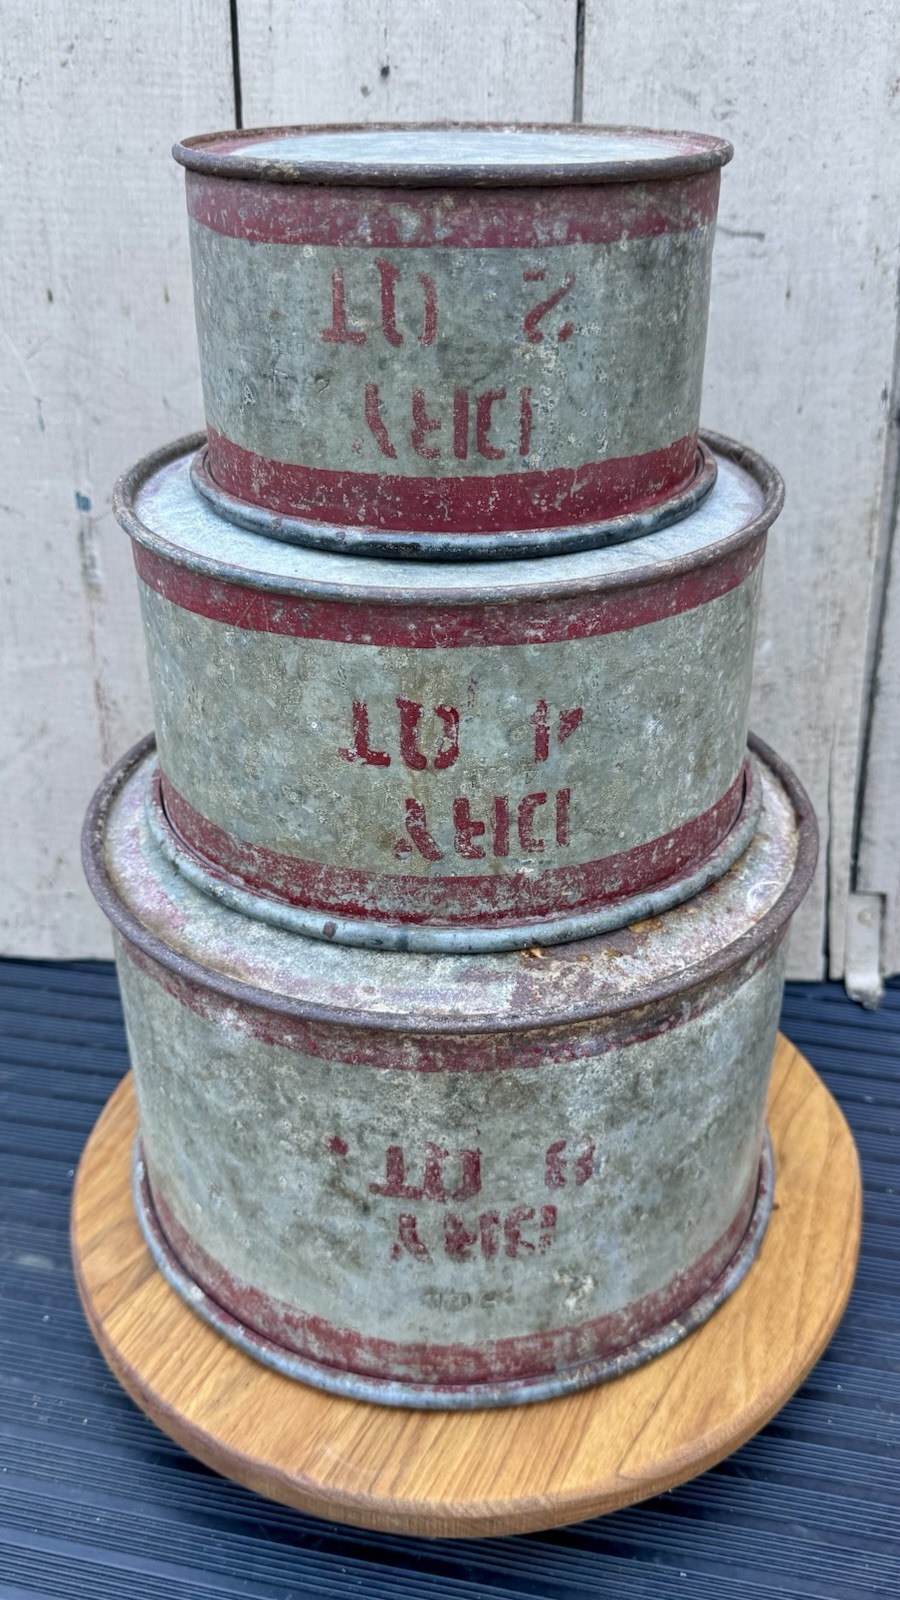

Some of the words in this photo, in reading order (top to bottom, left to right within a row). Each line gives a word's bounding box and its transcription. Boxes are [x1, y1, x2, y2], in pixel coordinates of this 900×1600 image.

[319, 257, 438, 347] QT
[522, 269, 576, 344] 2
[352, 382, 532, 460] DRY
[338, 695, 459, 770] QT
[530, 699, 584, 763] 4
[393, 787, 571, 861] DRY
[544, 1135, 597, 1190] 8
[391, 1203, 557, 1262] DRY
